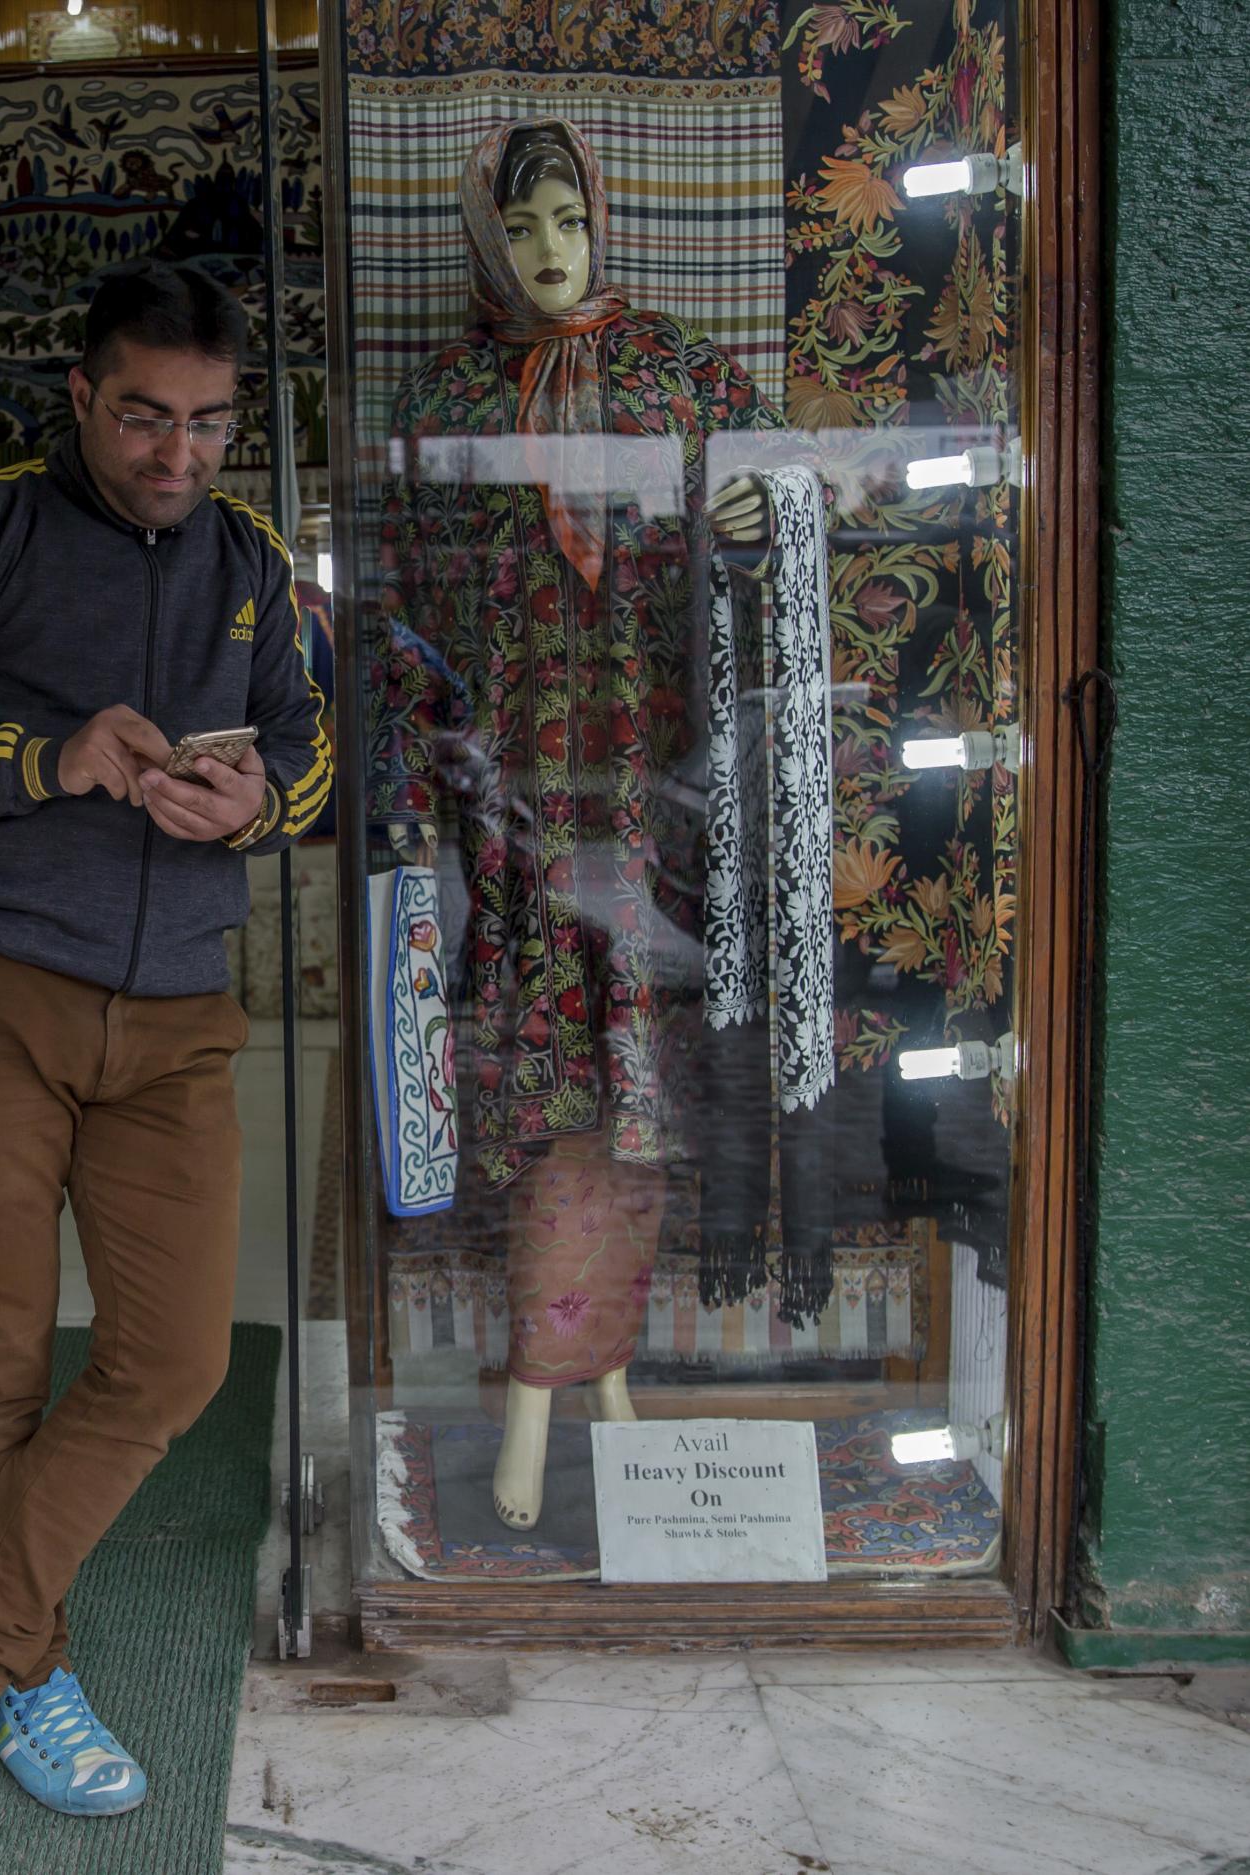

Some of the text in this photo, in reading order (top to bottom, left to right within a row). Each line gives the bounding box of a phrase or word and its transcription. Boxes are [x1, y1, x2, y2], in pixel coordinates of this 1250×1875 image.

[673, 1433, 730, 1452] Avail
[624, 1462, 787, 1484] Heavy Discount
[690, 1489, 722, 1507] On
[627, 1513, 791, 1525] Pure Pashmina, Semi Pashmina
[664, 1528, 748, 1538] Shawls & Stoles
